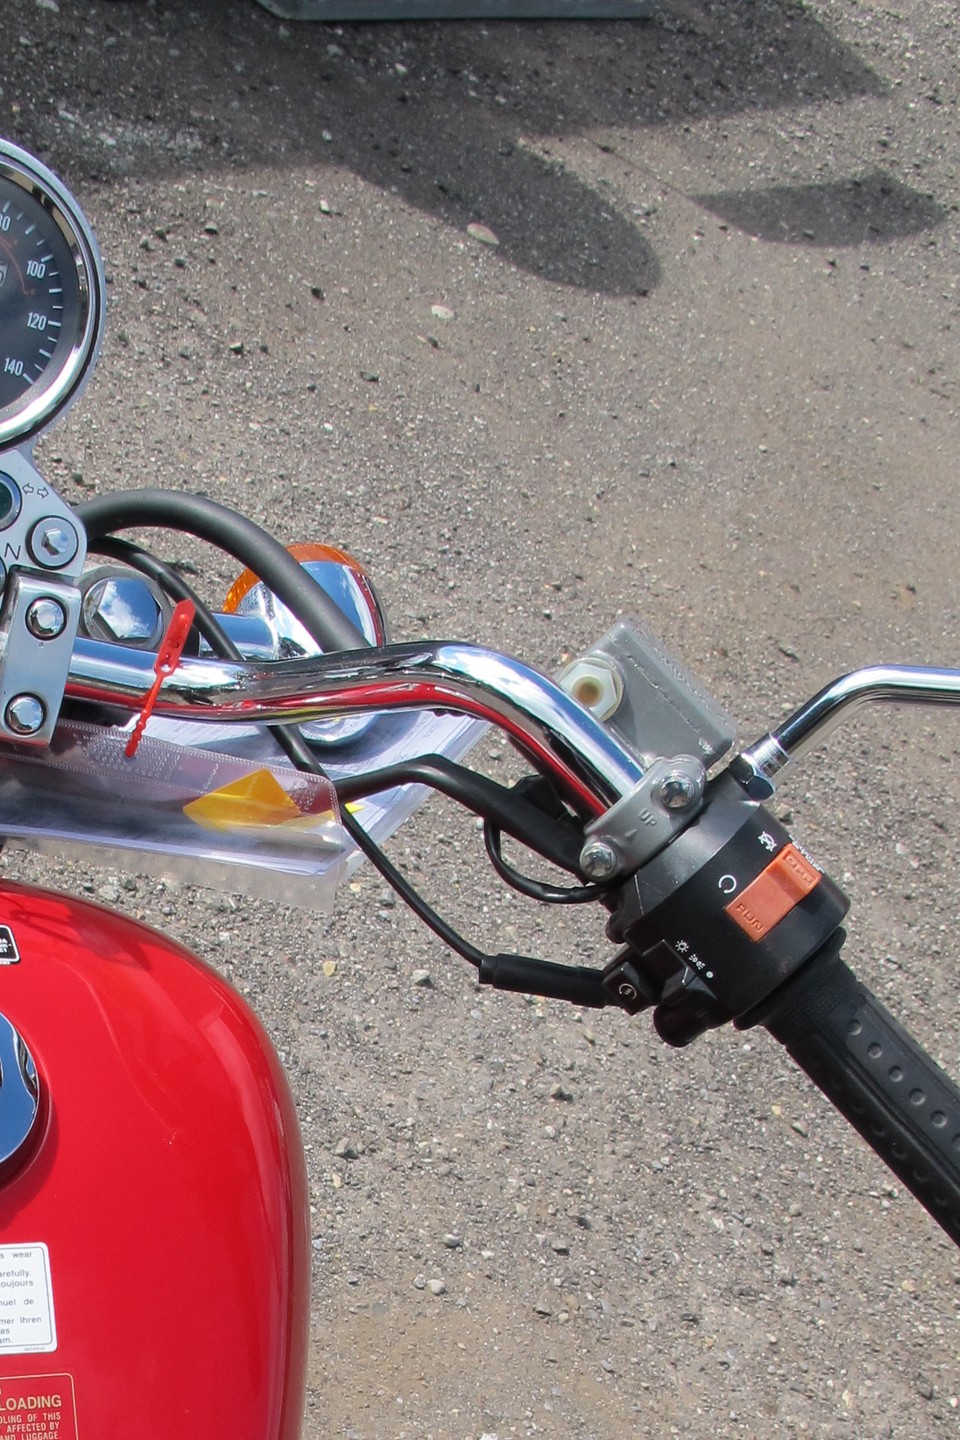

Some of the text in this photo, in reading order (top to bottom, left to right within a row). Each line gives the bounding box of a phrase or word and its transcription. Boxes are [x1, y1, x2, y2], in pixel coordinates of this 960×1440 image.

[26, 260, 46, 279] 100
[26, 312, 46, 330] 120
[4, 356, 24, 376] 140
[4, 542, 22, 560] N
[638, 810, 656, 826] UP
[735, 903, 764, 933] RUN
[27, 1413, 37, 1422] OF
[43, 1411, 61, 1421] THIS
[6, 1422, 46, 1433] AFFECTED
[49, 1421, 60, 1430] BY
